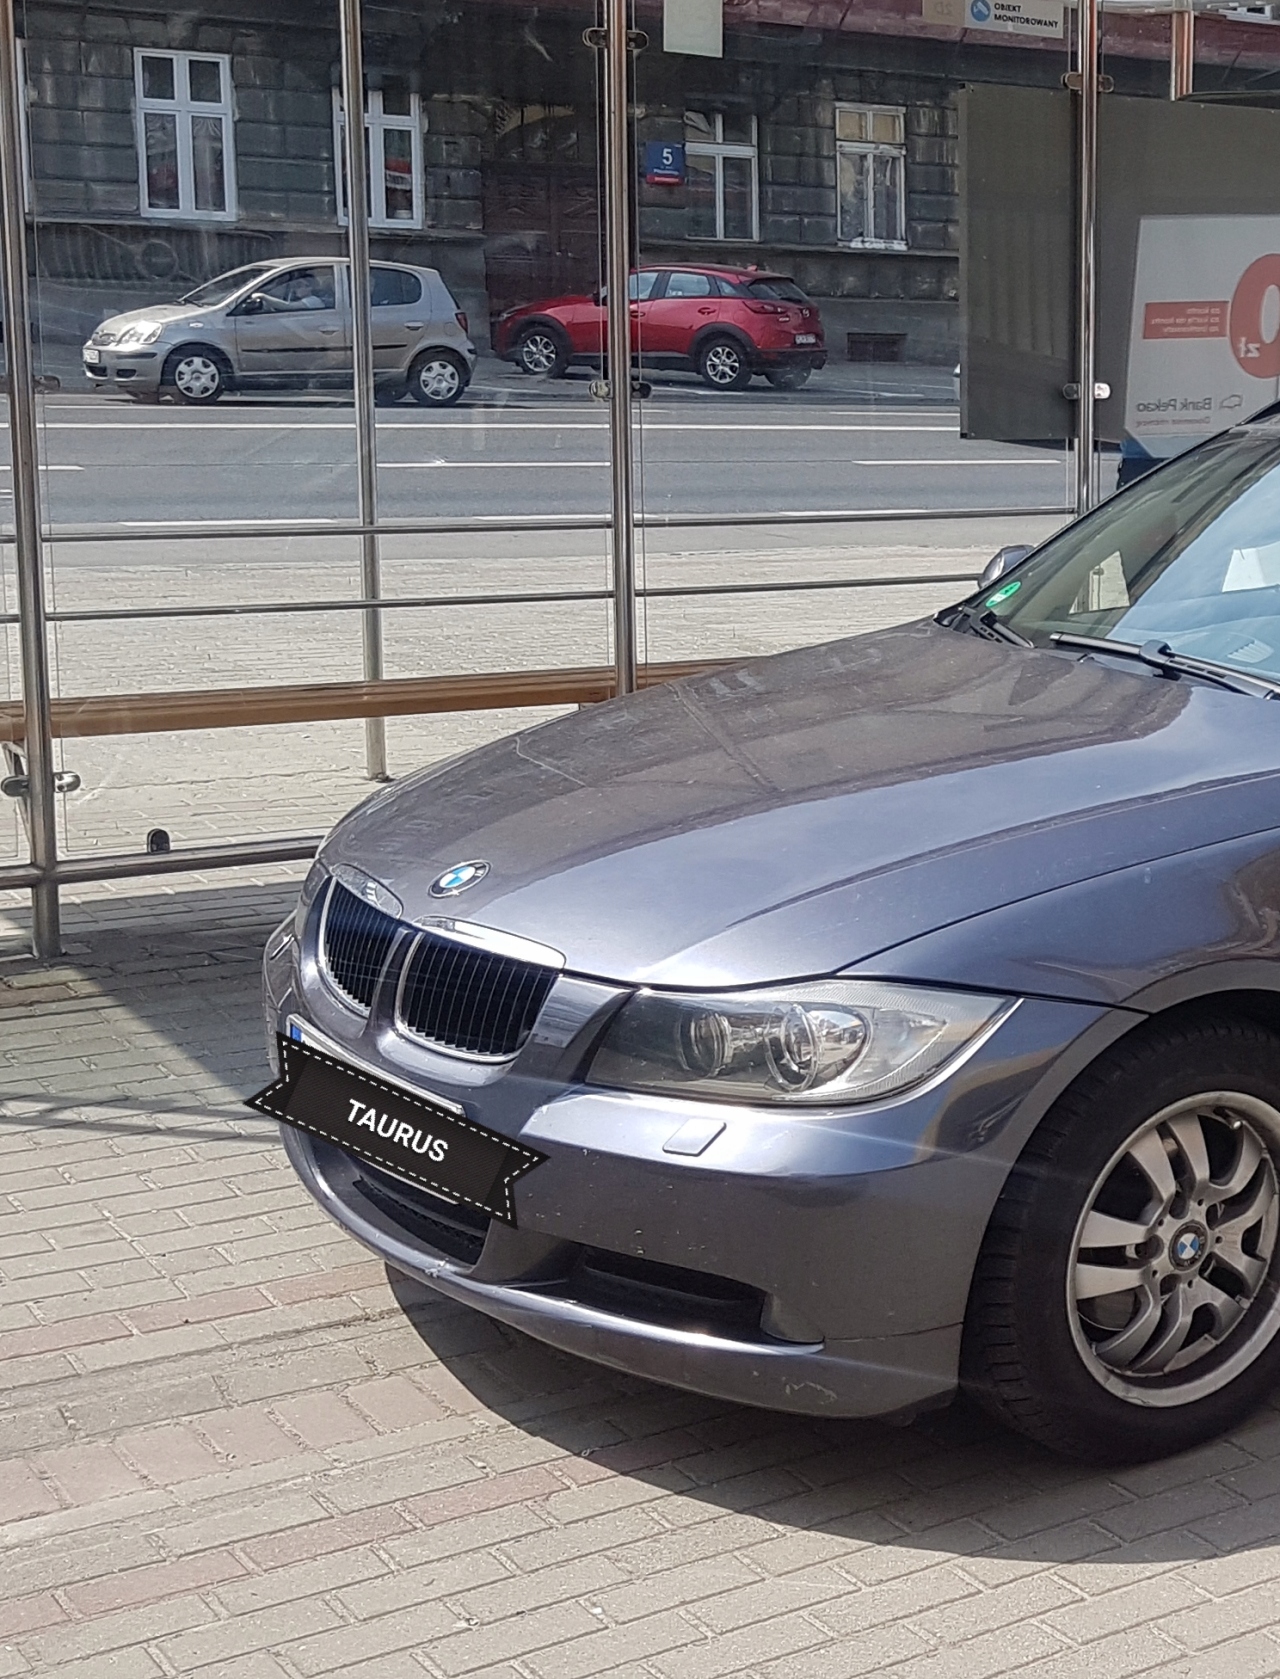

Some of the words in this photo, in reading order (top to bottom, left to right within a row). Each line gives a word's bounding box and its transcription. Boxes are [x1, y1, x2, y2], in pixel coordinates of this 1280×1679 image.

[994, 2, 1022, 13] OBIEKT
[993, 13, 1059, 29] MONITOROWANY
[662, 148, 673, 165] 5
